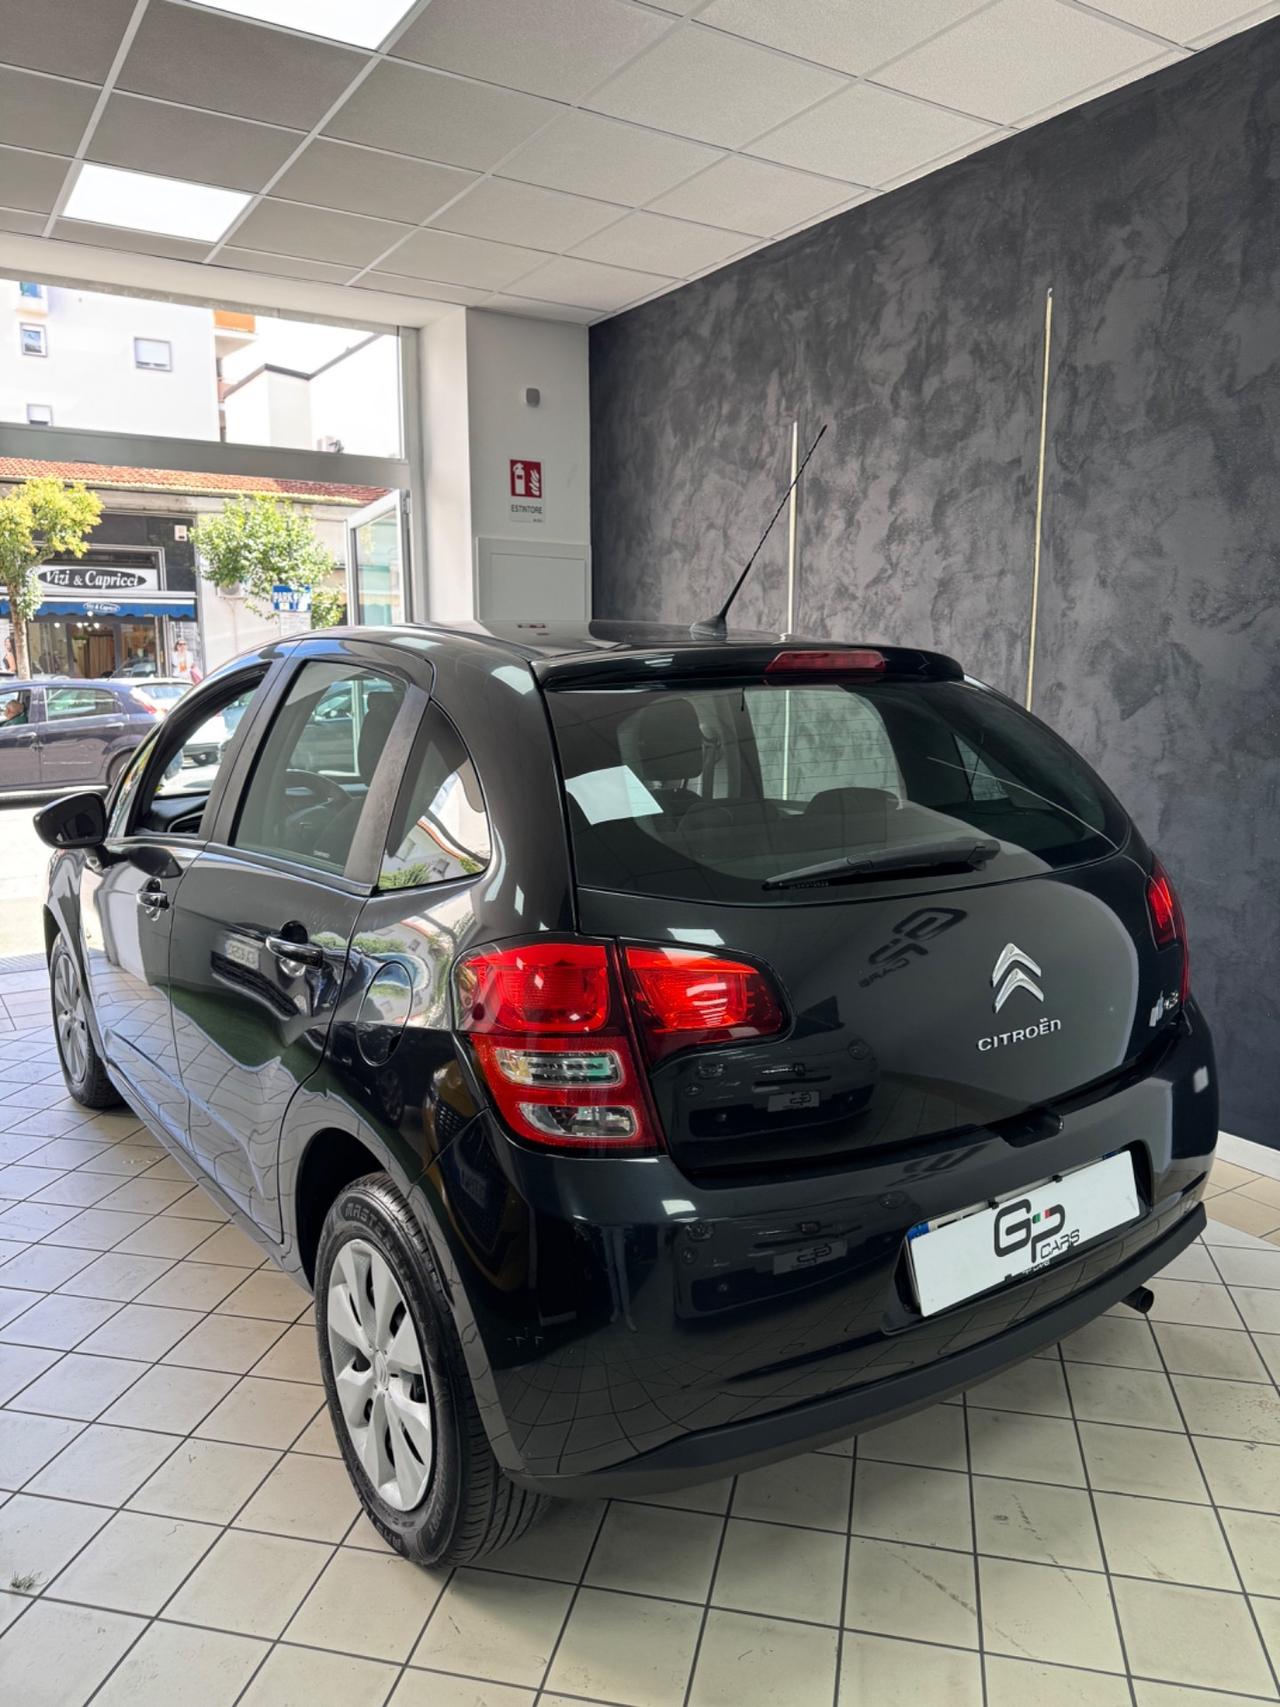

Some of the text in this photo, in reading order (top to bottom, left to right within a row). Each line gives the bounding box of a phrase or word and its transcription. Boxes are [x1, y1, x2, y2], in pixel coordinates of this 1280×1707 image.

[511, 504, 543, 514] ESTINTORE
[46, 570, 138, 589] Vizi & Capricci
[1041, 1229, 1080, 1259] CARS
